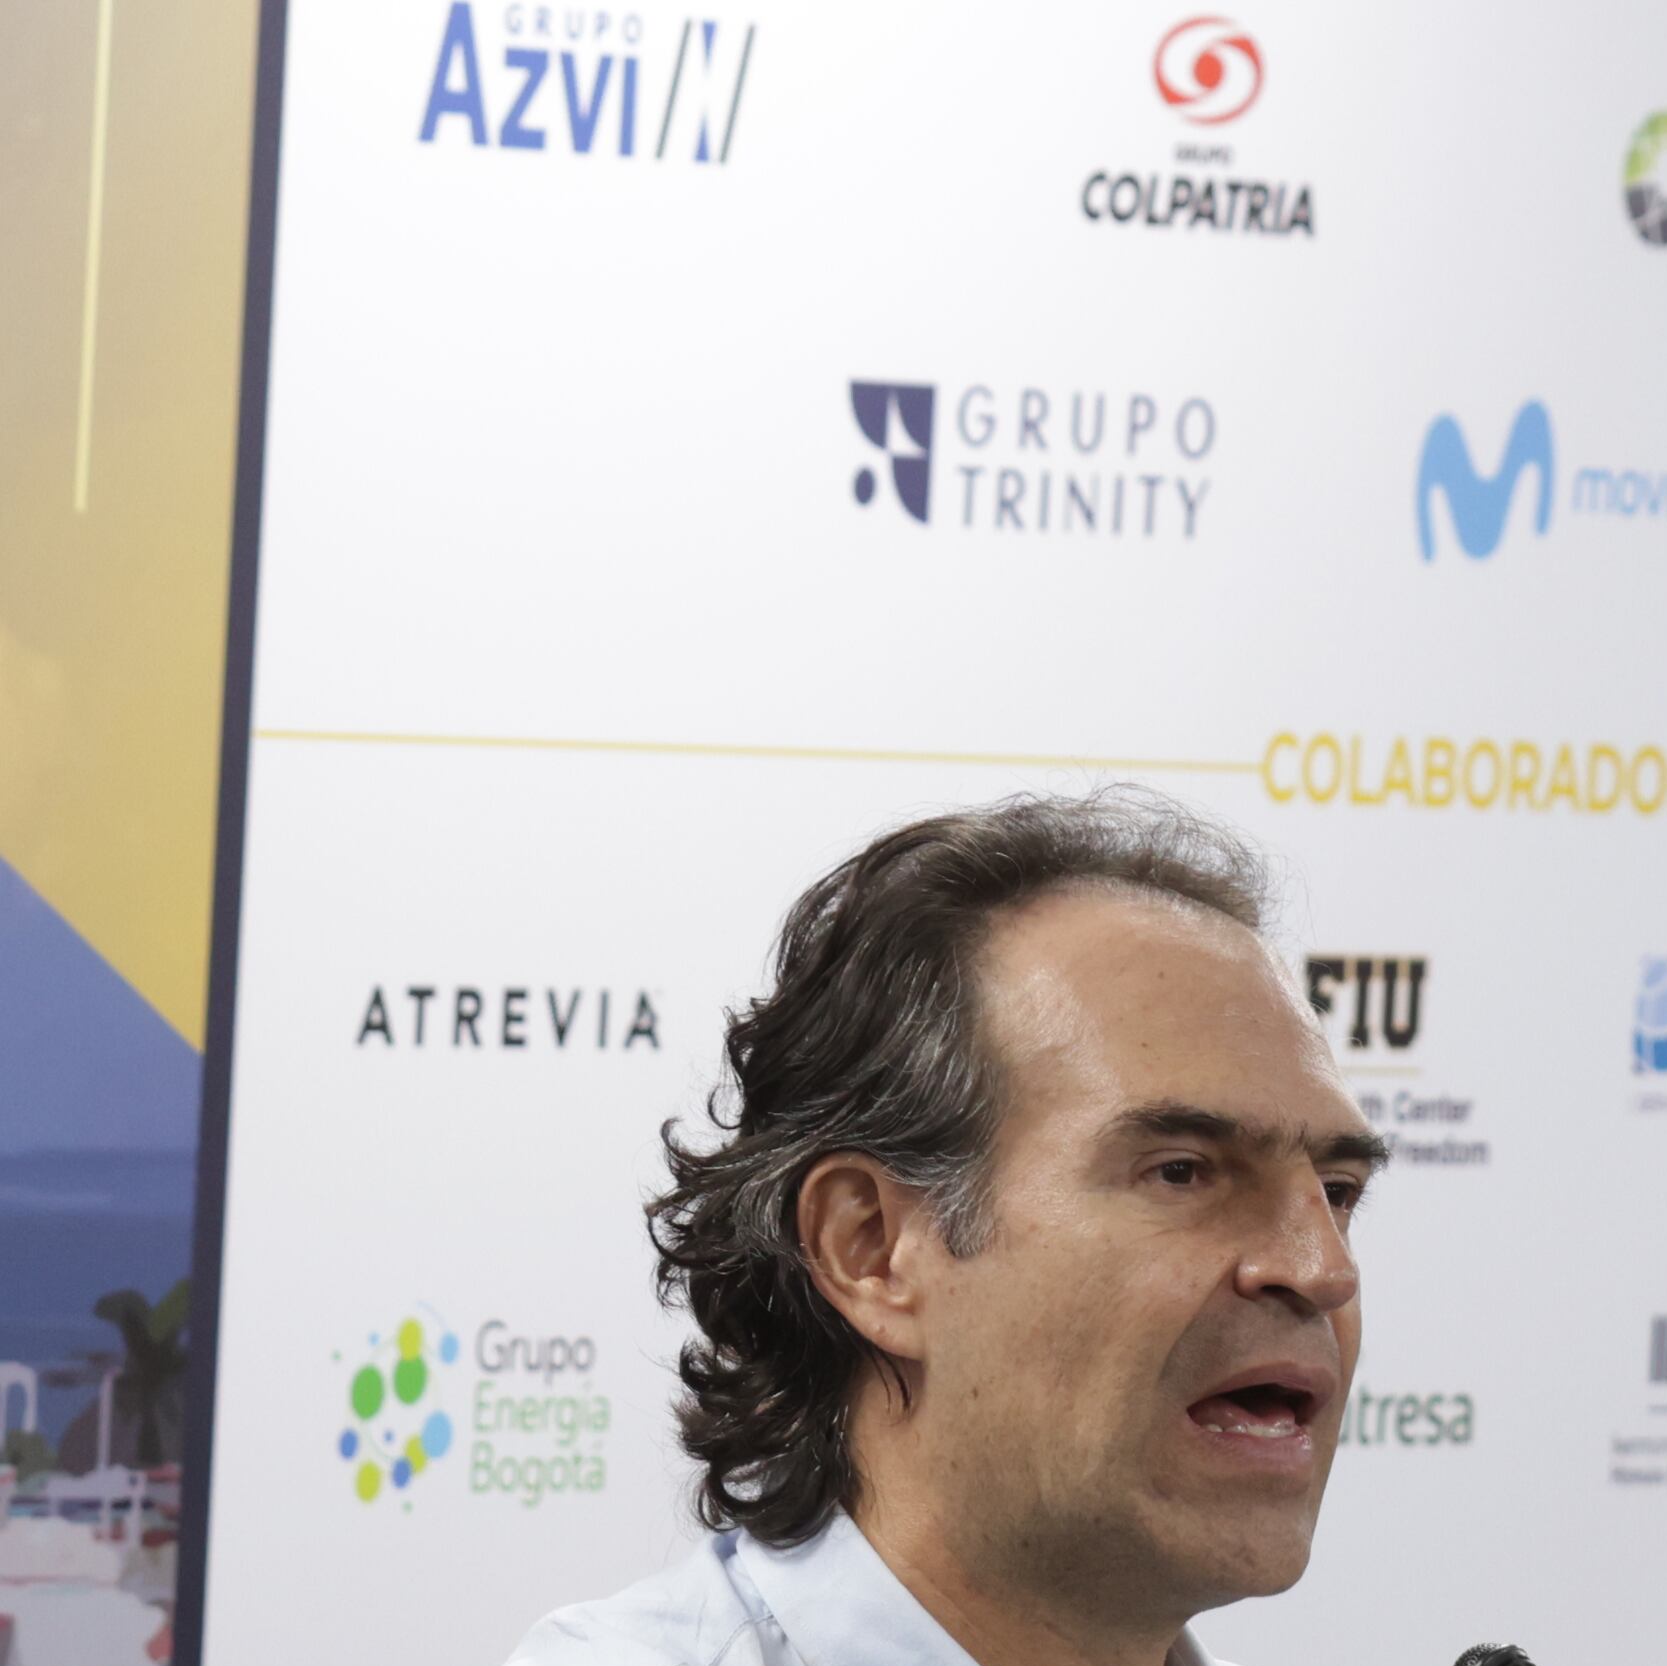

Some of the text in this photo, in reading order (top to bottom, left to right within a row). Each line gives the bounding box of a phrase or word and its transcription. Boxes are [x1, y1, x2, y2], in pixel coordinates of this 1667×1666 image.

[1081, 169, 1315, 236] COLPATRIA
[956, 384, 1217, 460] GRUPO
[956, 465, 1213, 539] TRINITY
[356, 985, 661, 1049] ATREVIA
[1306, 956, 1425, 1048] FIU
[476, 1319, 597, 1387] Grupo
